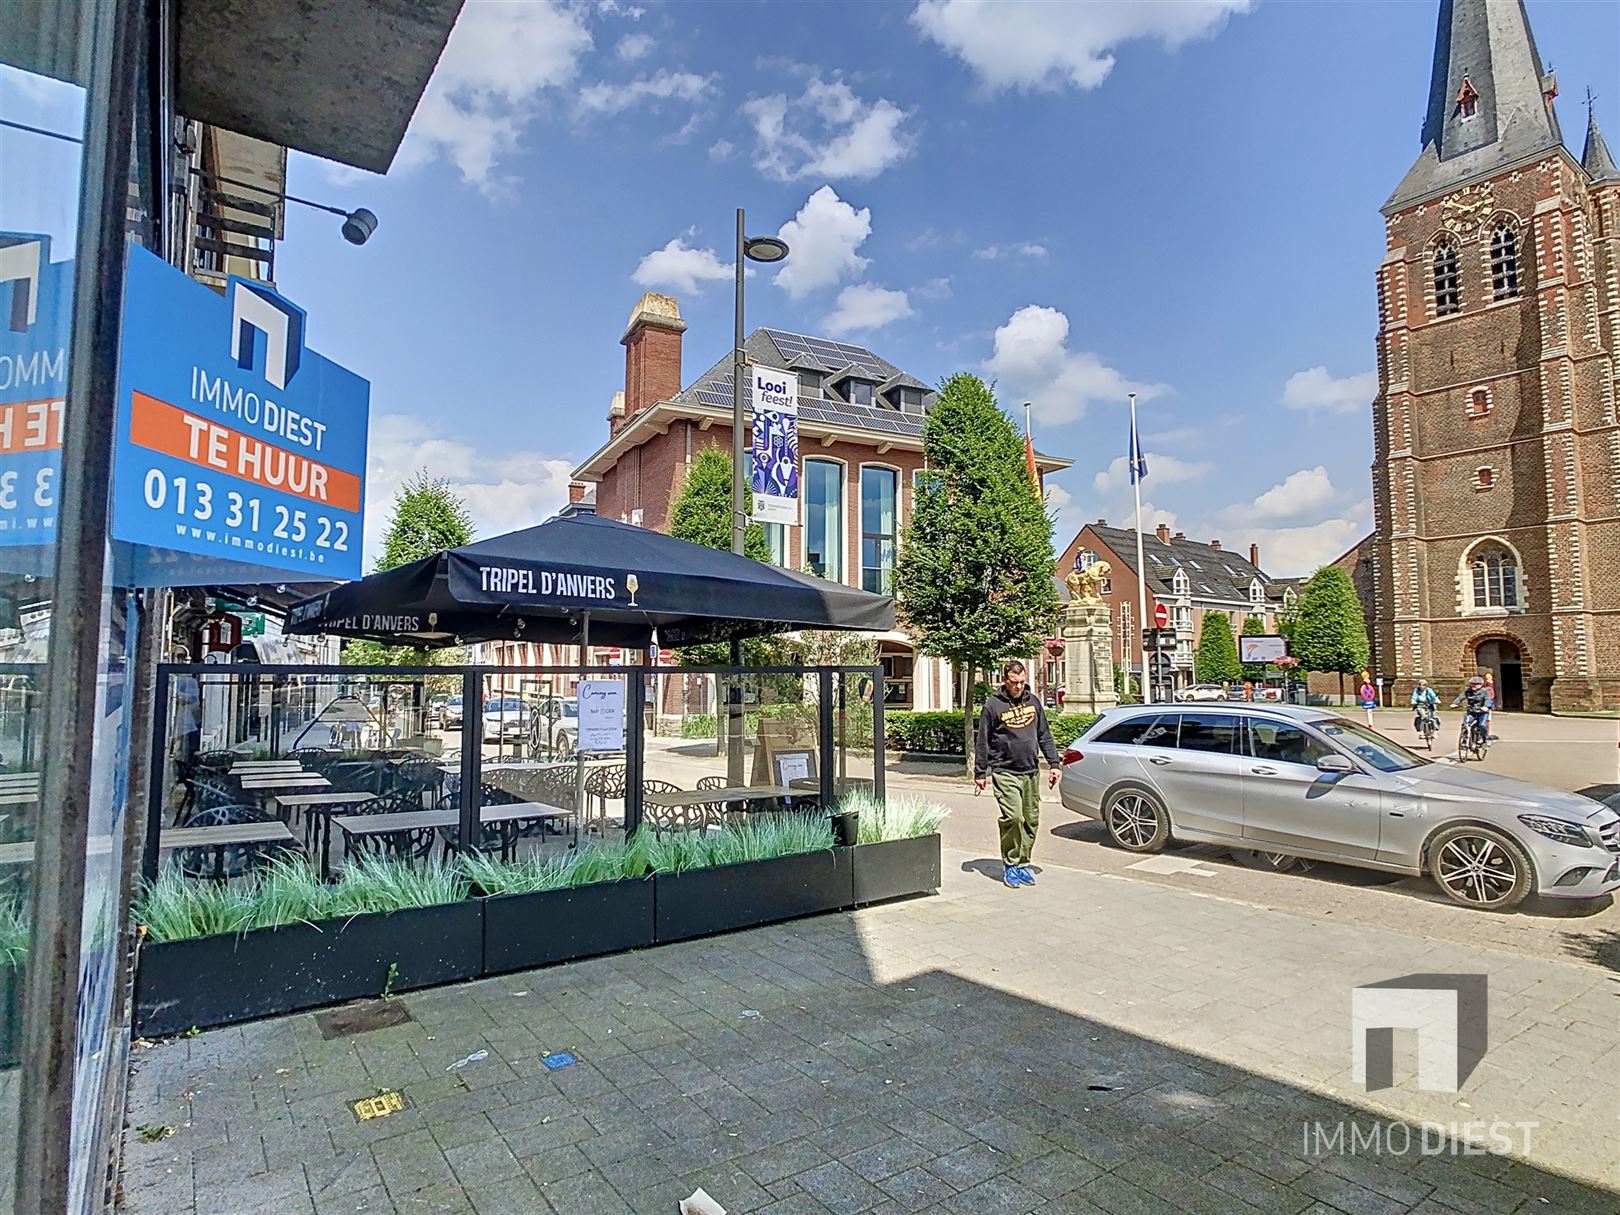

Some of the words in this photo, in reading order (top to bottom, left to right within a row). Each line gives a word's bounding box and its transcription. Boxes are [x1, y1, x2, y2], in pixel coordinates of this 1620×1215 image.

[757, 376, 787, 395] Looi
[760, 390, 793, 408] feest!
[191, 366, 260, 424] IMMO
[263, 400, 327, 451] DIEST
[183, 414, 229, 469] TE
[237, 436, 329, 501] HUUR
[144, 468, 213, 520] 013
[225, 491, 261, 532] 31
[272, 505, 307, 542] 25
[315, 516, 349, 552] 22
[175, 523, 325, 564] www.immodiest.be
[479, 566, 537, 595] TRIPEL
[541, 571, 616, 600] D'ANVERS
[361, 613, 420, 632] D'ANVERS
